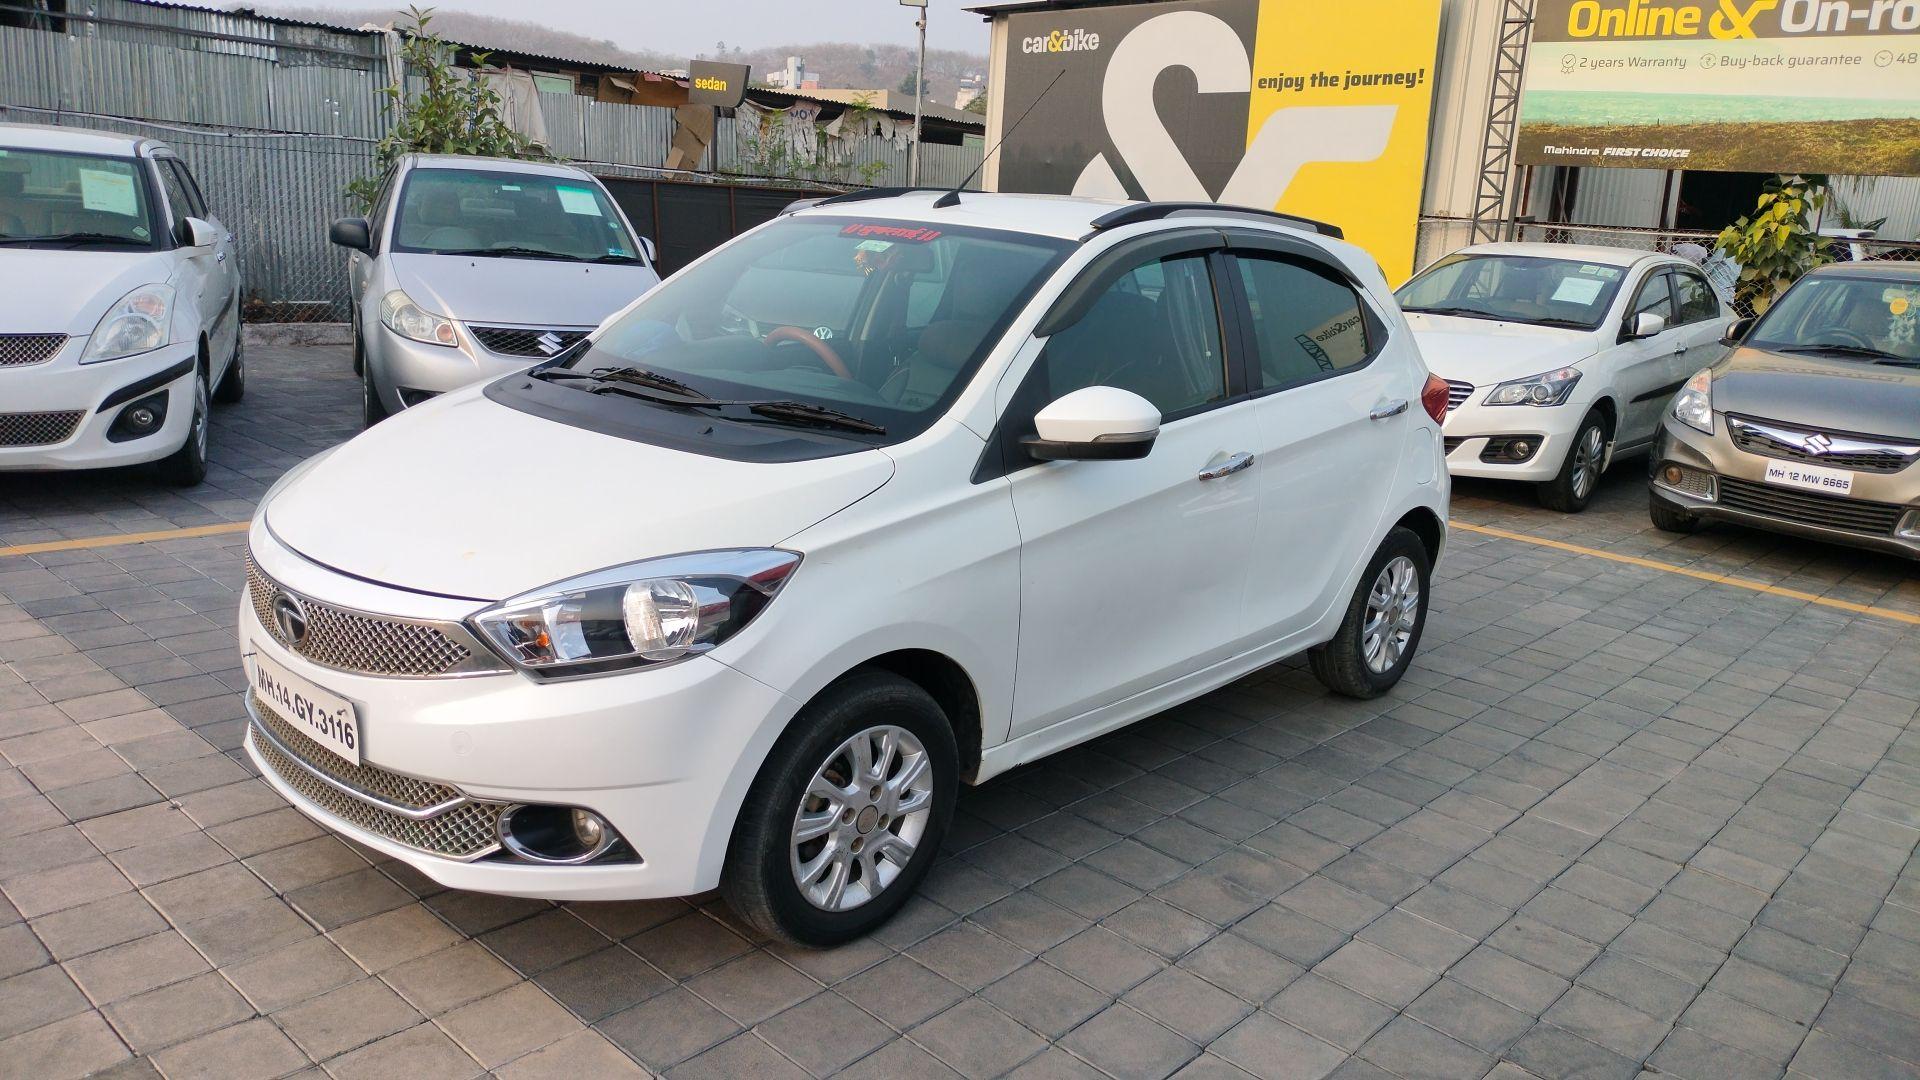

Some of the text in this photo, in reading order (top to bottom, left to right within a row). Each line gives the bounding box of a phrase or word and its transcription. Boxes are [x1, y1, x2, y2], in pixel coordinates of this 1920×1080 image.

[1568, 0, 1701, 37] Online
[1708, 0, 1778, 41] &
[1022, 28, 1100, 53] car&bike
[1579, 56, 1687, 70] 2 years Warranty
[1720, 54, 1862, 69] Buy-back guarantee
[1896, 52, 1918, 64] 48
[695, 76, 727, 91] sedan
[1258, 68, 1425, 92] enjoy the journey!
[1602, 147, 1642, 156] FIRST
[1641, 148, 1691, 158] CHOICE
[1768, 468, 1849, 489] MH 12 MW 6665
